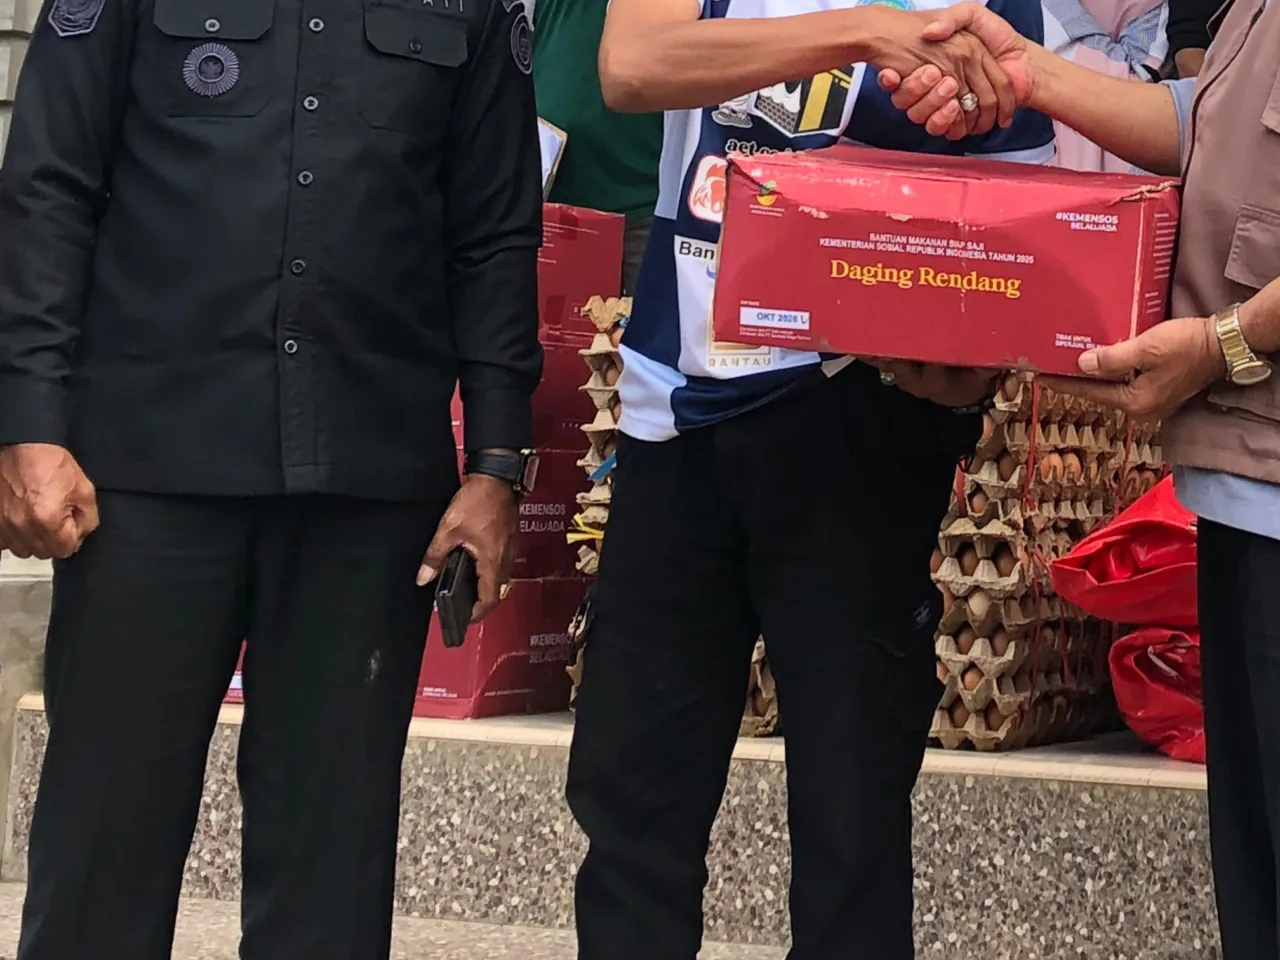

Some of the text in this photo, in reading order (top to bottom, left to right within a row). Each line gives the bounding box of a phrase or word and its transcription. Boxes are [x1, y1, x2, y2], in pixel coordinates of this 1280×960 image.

[1055, 212, 1119, 225] #KEMENSOS
[678, 241, 715, 261] Ban
[819, 238, 875, 250] KEMENTERIAN
[876, 242, 905, 253] SOSIAL
[906, 244, 945, 257] REPUBLIK
[946, 248, 987, 261] INDONESIA
[989, 252, 1015, 263] TAHUN
[869, 232, 985, 252] BANTUAN MAKANAN SIAP SAJI
[830, 259, 1022, 299] Daging Rendang
[756, 312, 776, 322] OKT
[519, 503, 566, 516] KEMENSOS
